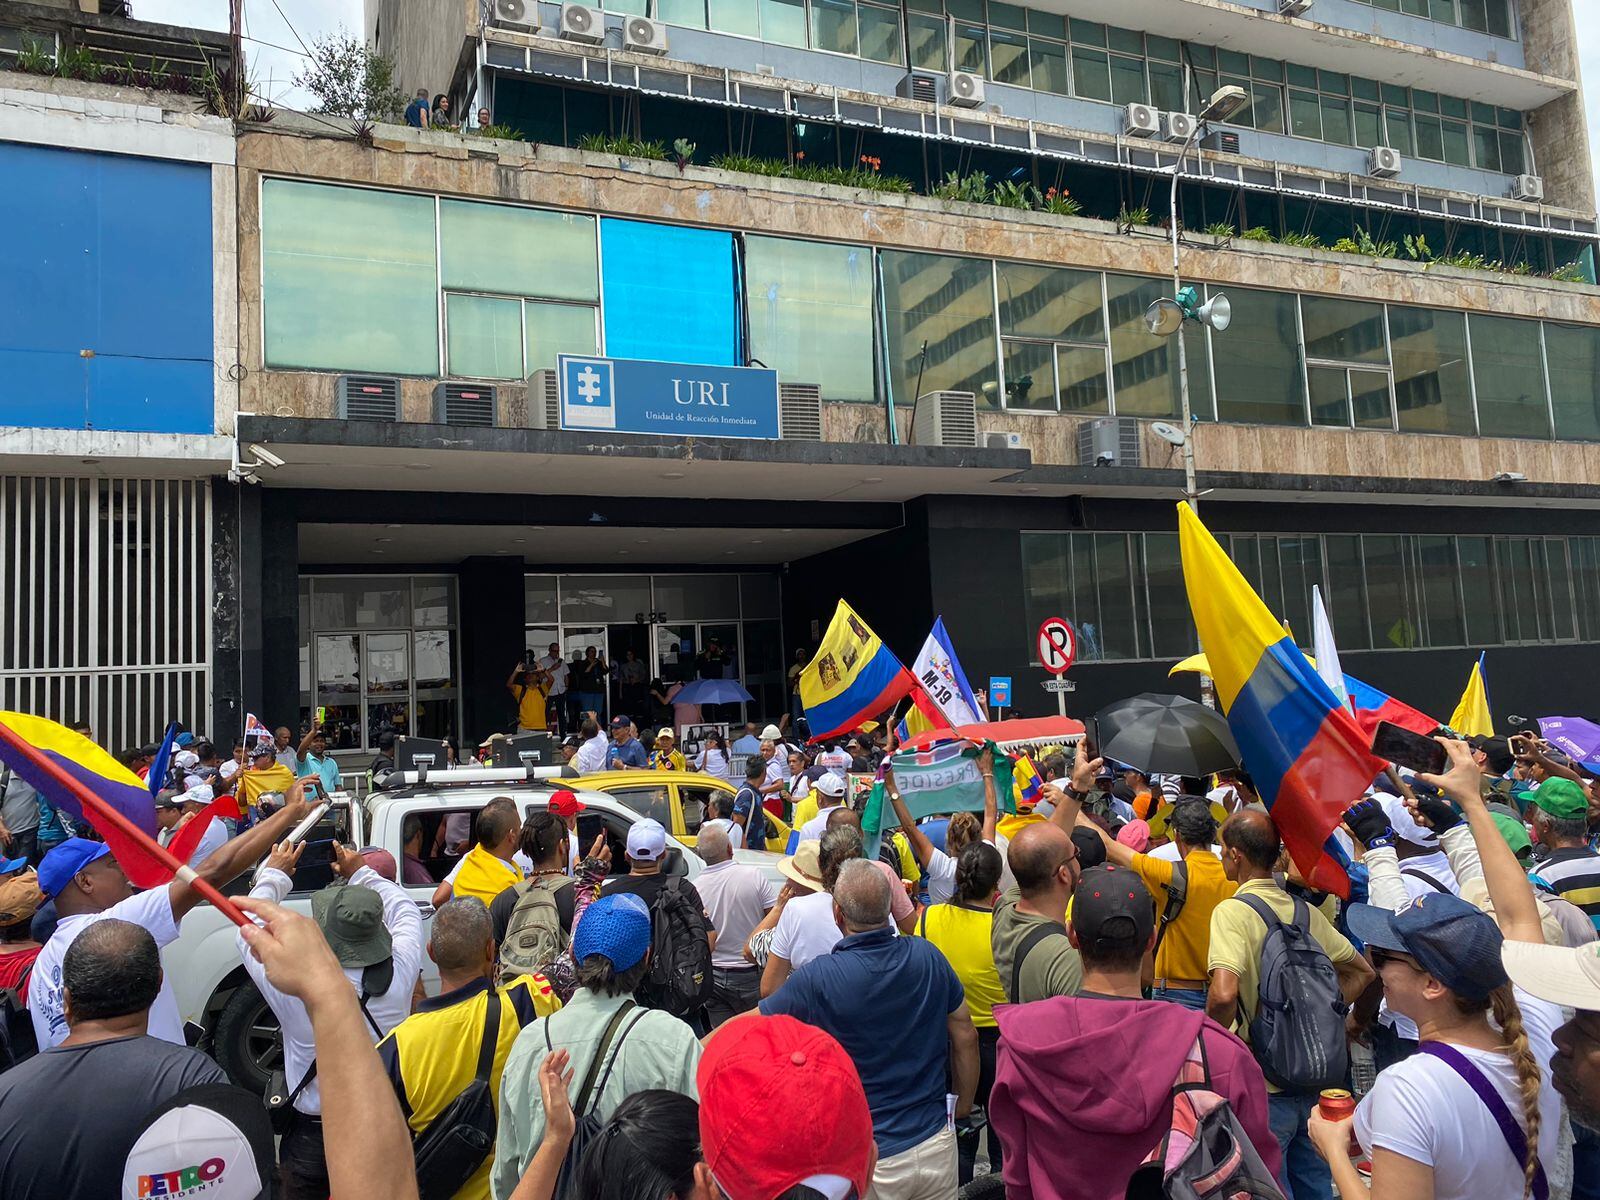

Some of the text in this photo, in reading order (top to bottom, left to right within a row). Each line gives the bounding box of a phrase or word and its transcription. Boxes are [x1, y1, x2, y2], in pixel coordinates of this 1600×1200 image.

[671, 379, 730, 407] URI
[645, 410, 757, 425] Unidad de Reacción Inmediata
[1048, 626, 1068, 665] P
[921, 669, 953, 706] M-19
[138, 1158, 226, 1198] PETRO
[138, 1176, 225, 1200] ESIDENTE
